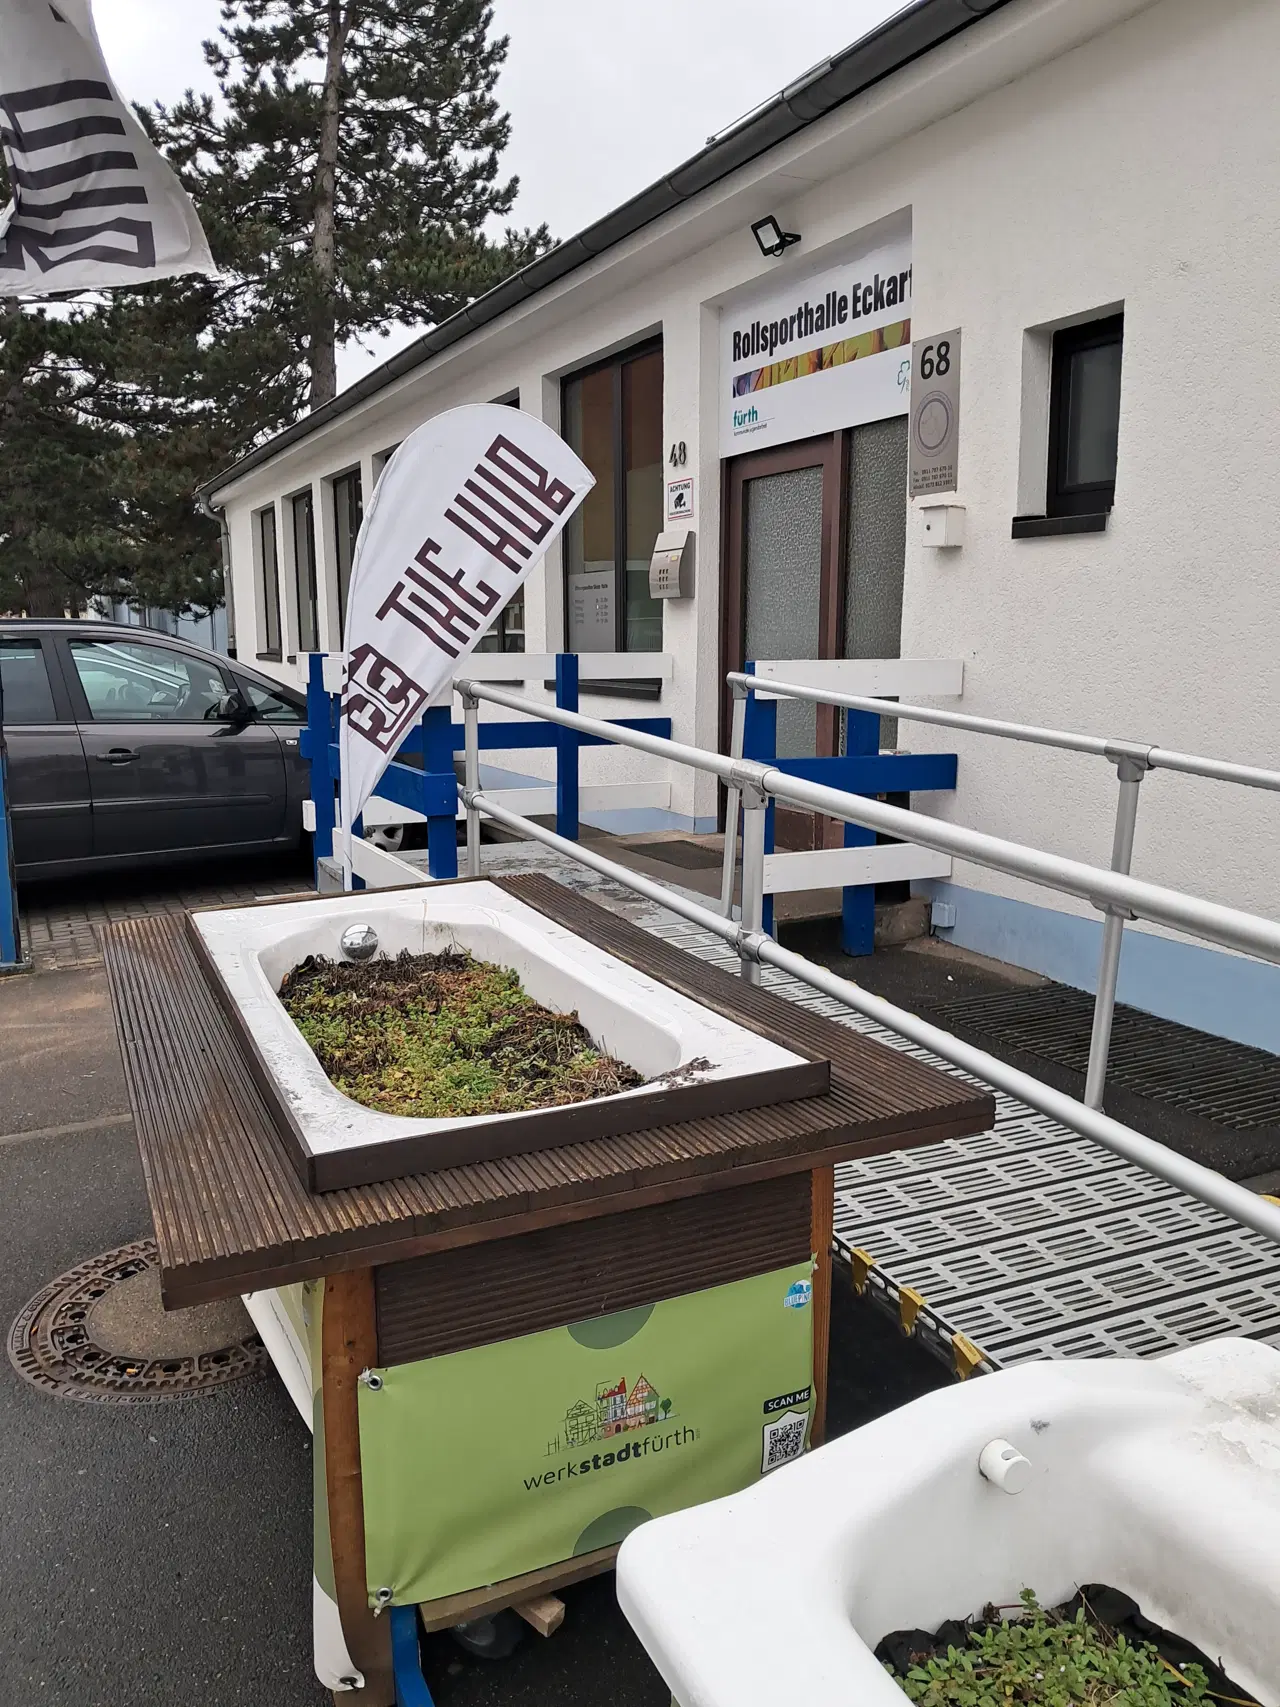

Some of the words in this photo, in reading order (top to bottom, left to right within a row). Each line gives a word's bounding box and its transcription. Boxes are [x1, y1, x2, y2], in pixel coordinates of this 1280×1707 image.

[732, 291, 848, 362] Rollsporthalle
[920, 341, 950, 379] 68
[733, 405, 758, 428] fürth
[669, 441, 687, 467] 48
[669, 482, 691, 493] ACHTUNG
[375, 537, 501, 659] THE
[444, 433, 576, 575] HUB
[768, 1396, 794, 1410] SCAN
[795, 1390, 809, 1402] ME
[523, 1425, 695, 1491] werkstadtfürth
